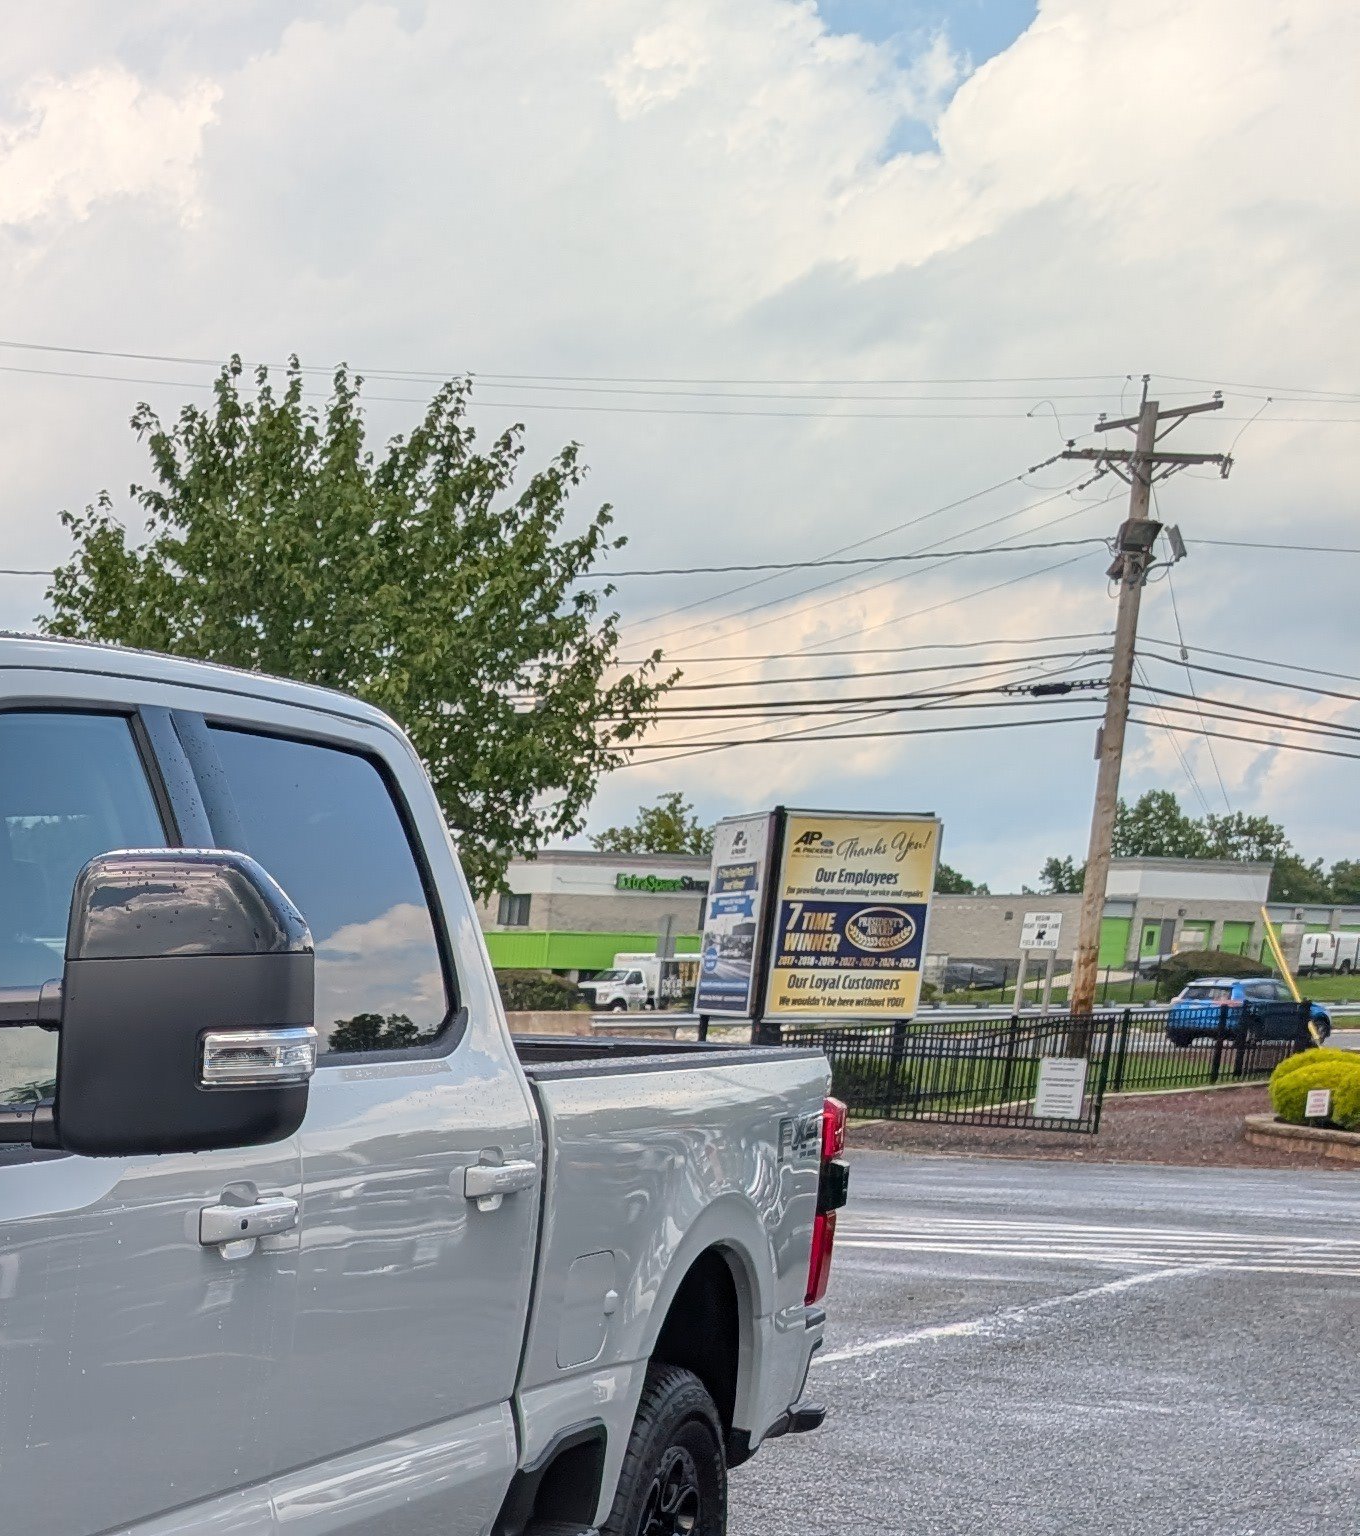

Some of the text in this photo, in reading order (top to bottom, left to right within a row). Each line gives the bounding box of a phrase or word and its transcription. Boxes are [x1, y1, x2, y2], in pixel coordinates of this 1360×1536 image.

[793, 830, 822, 845] AP
[836, 830, 932, 862] Thanks You!
[815, 867, 899, 887] Our Employees
[796, 886, 825, 896] providing
[870, 888, 890, 896] service
[891, 889, 902, 897] and
[902, 889, 923, 898] repairs
[786, 903, 837, 931] 7 TIME
[784, 933, 842, 952] WINNER
[787, 974, 901, 992] Our Loyal Customers
[779, 996, 790, 1005] We
[791, 996, 826, 1006] wouldn't
[827, 997, 836, 1006] be
[837, 997, 854, 1006] here
[855, 997, 885, 1007] without
